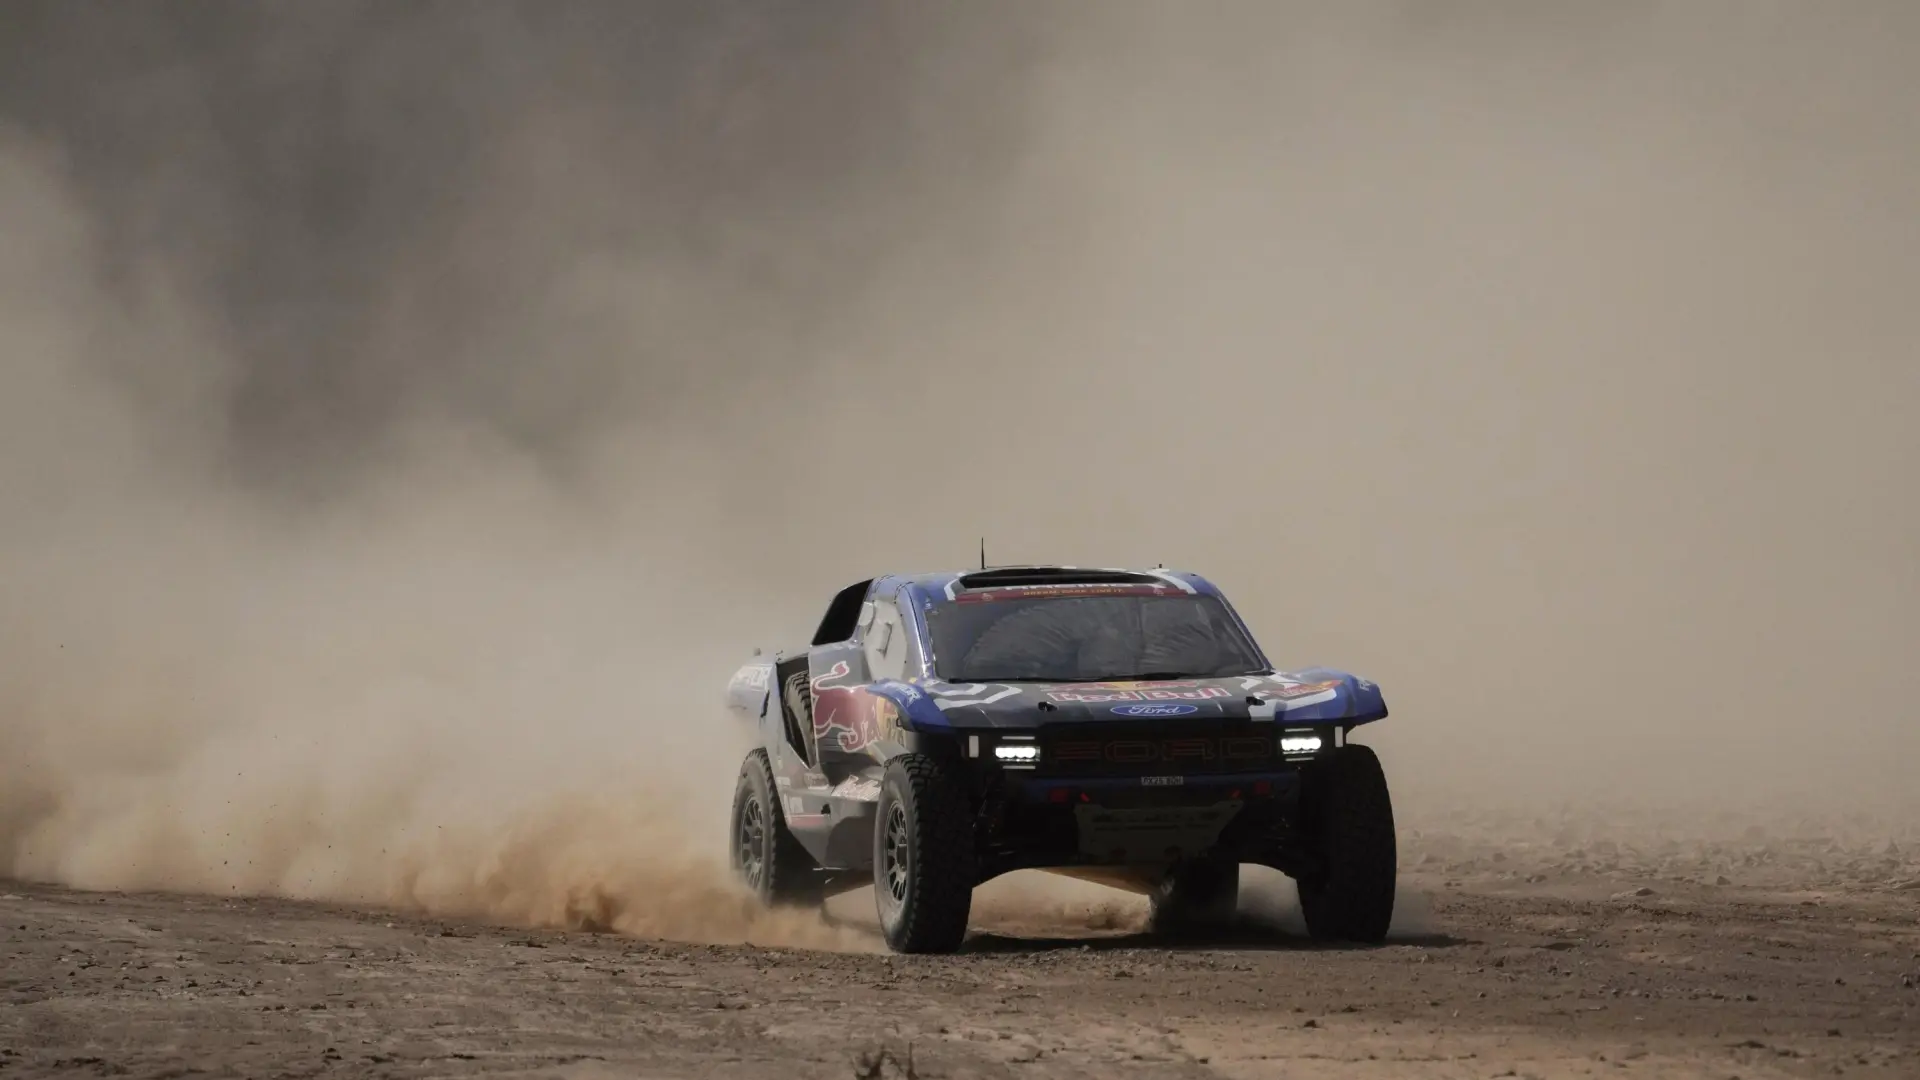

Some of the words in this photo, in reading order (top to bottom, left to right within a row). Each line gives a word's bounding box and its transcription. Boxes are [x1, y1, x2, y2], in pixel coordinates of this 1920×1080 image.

[1047, 690, 1143, 703] Red
[1139, 687, 1233, 701] Bull
[1128, 703, 1180, 715] Ford
[1049, 736, 1272, 763] FORD
